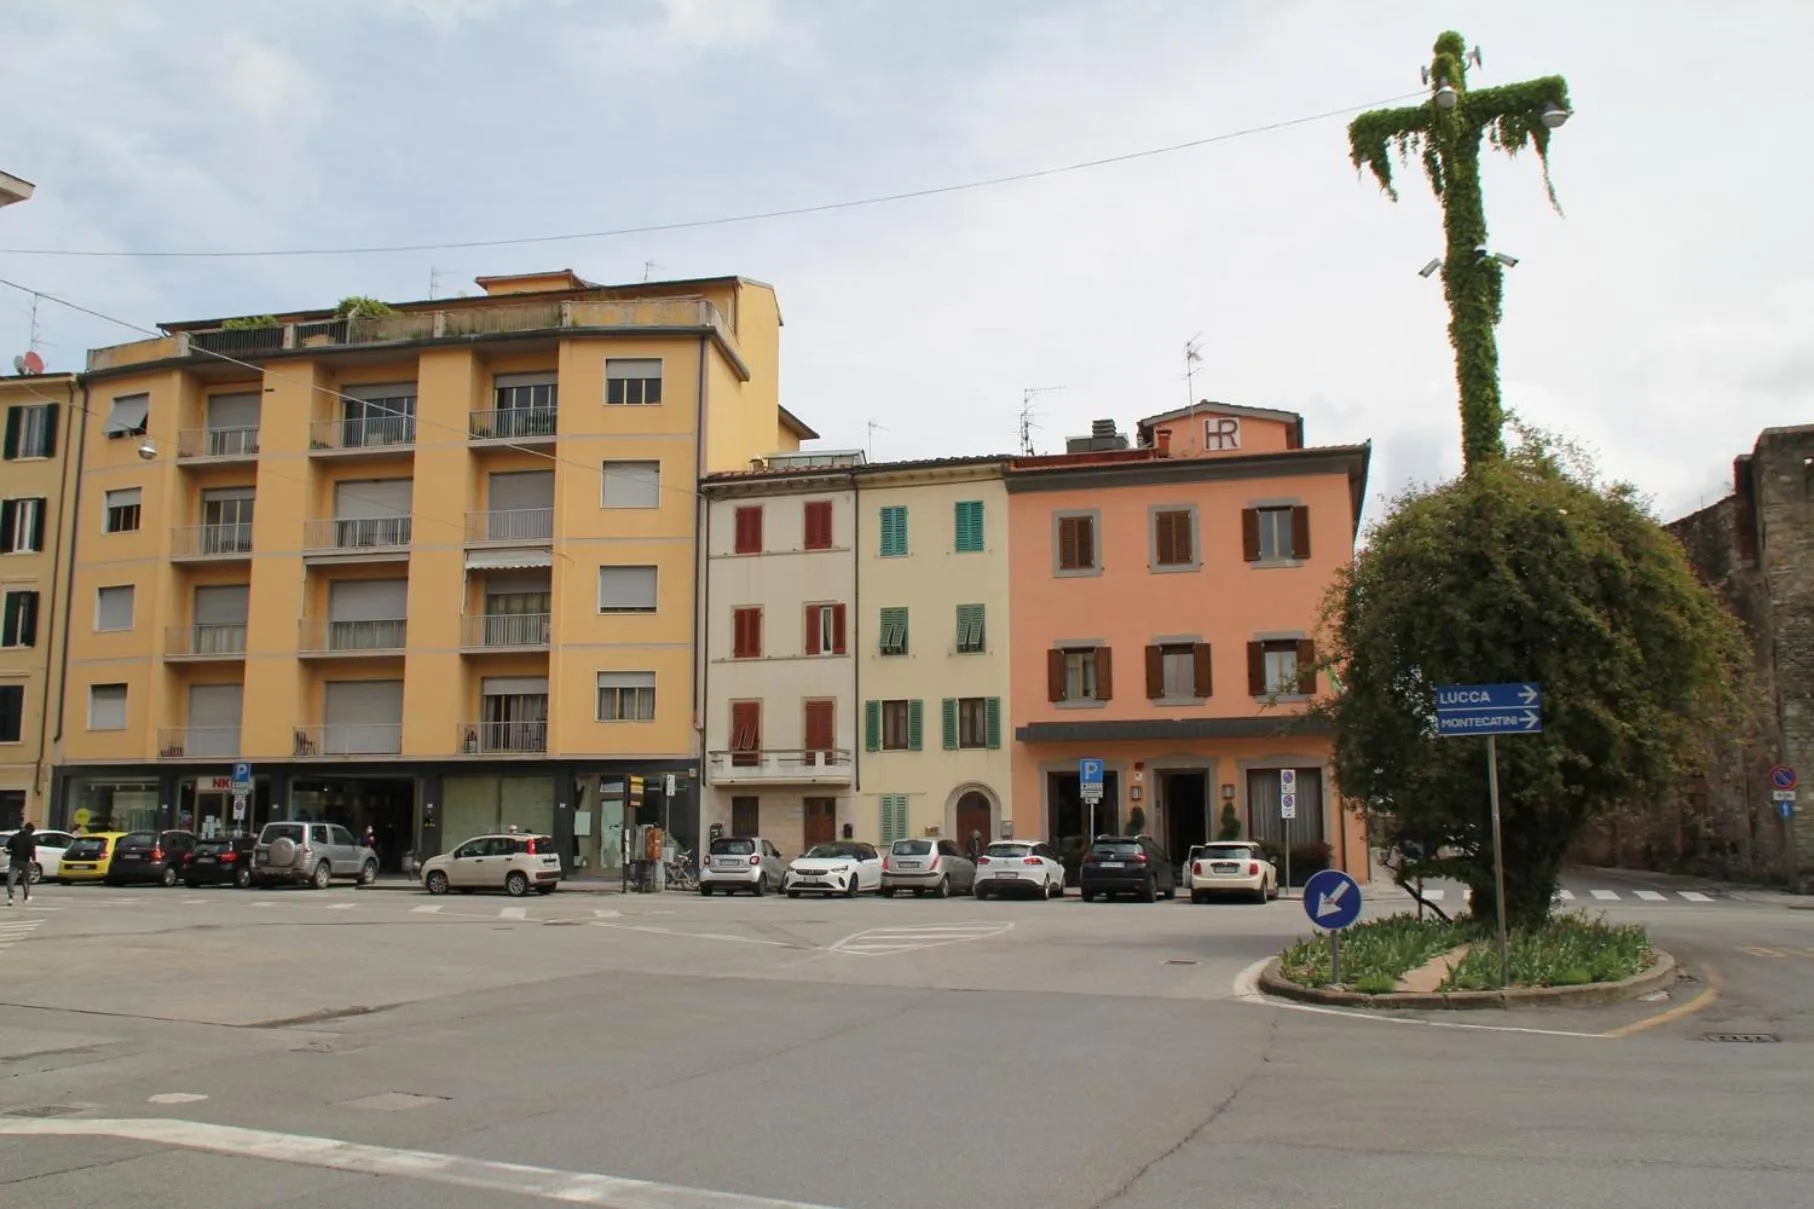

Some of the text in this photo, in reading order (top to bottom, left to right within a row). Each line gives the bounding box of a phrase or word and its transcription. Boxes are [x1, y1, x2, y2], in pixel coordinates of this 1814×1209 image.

[1440, 690, 1490, 704] LUCCA
[1441, 715, 1518, 729] MONTECATINI
[236, 763, 248, 780] P
[1085, 762, 1098, 780] P
